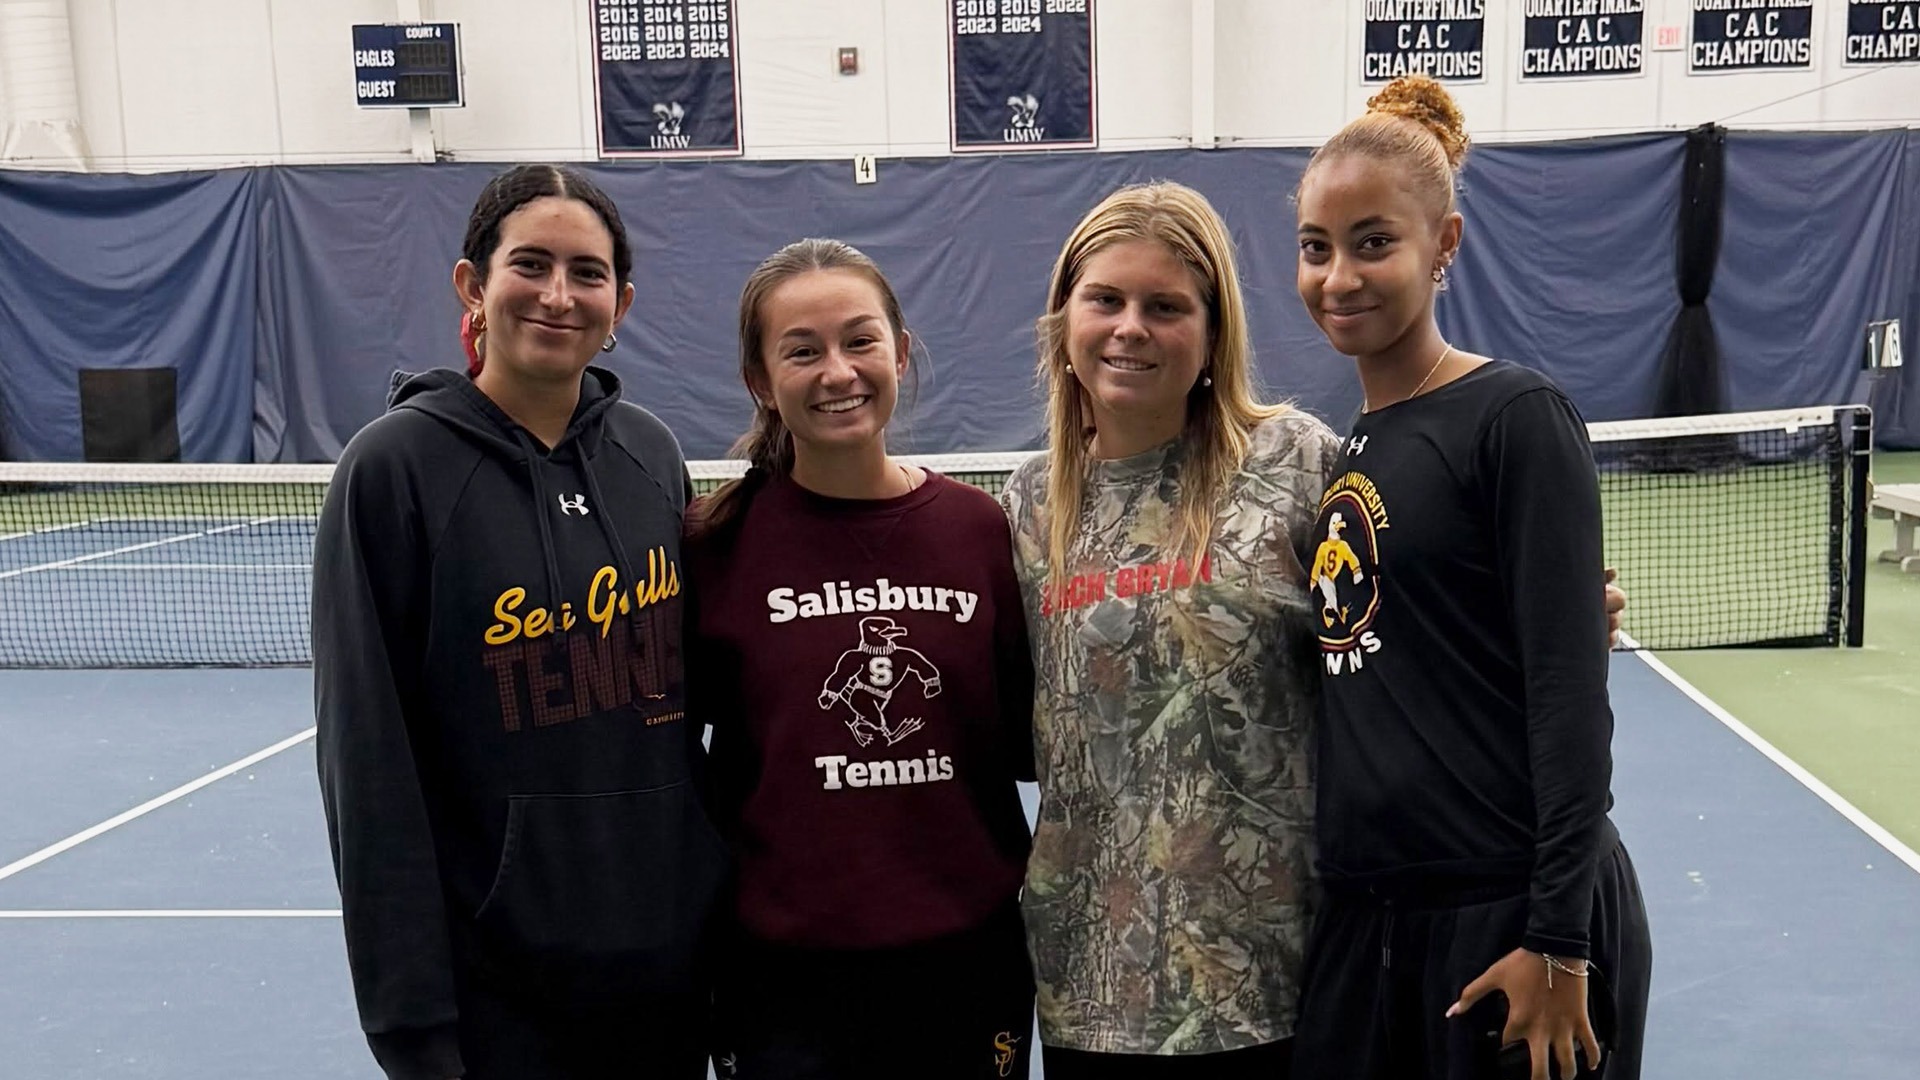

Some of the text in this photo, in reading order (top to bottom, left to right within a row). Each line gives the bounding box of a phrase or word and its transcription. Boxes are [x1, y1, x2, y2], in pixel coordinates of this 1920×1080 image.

[599, 5, 727, 24] 2013 2014 2015
[956, 0, 1086, 16] 2018 2019 2022
[405, 27, 433, 39] COURT
[600, 23, 729, 43] 2016 2018 2019
[957, 16, 1042, 35] 2023 2024
[601, 41, 730, 61] 2022 2023 2024
[1692, 38, 1810, 67] CHAMPIONS
[1847, 33, 1920, 59] CHAMP
[355, 49, 396, 68] EAGLES
[1365, 51, 1482, 77] CHAMPIONS
[1523, 43, 1641, 73] CHAMPIONS
[357, 80, 397, 98] GUEST
[650, 134, 691, 149] UMW
[1003, 127, 1045, 143] UMW
[860, 156, 871, 179] 4
[1868, 331, 1877, 368] 1
[1345, 471, 1391, 530] UNIVERSITY
[1327, 549, 1337, 572] S
[767, 578, 979, 623] Salisbury
[1041, 571, 1106, 618] ZCH
[484, 586, 577, 645] Sea
[869, 656, 893, 687] S
[814, 748, 954, 790] Tennis
